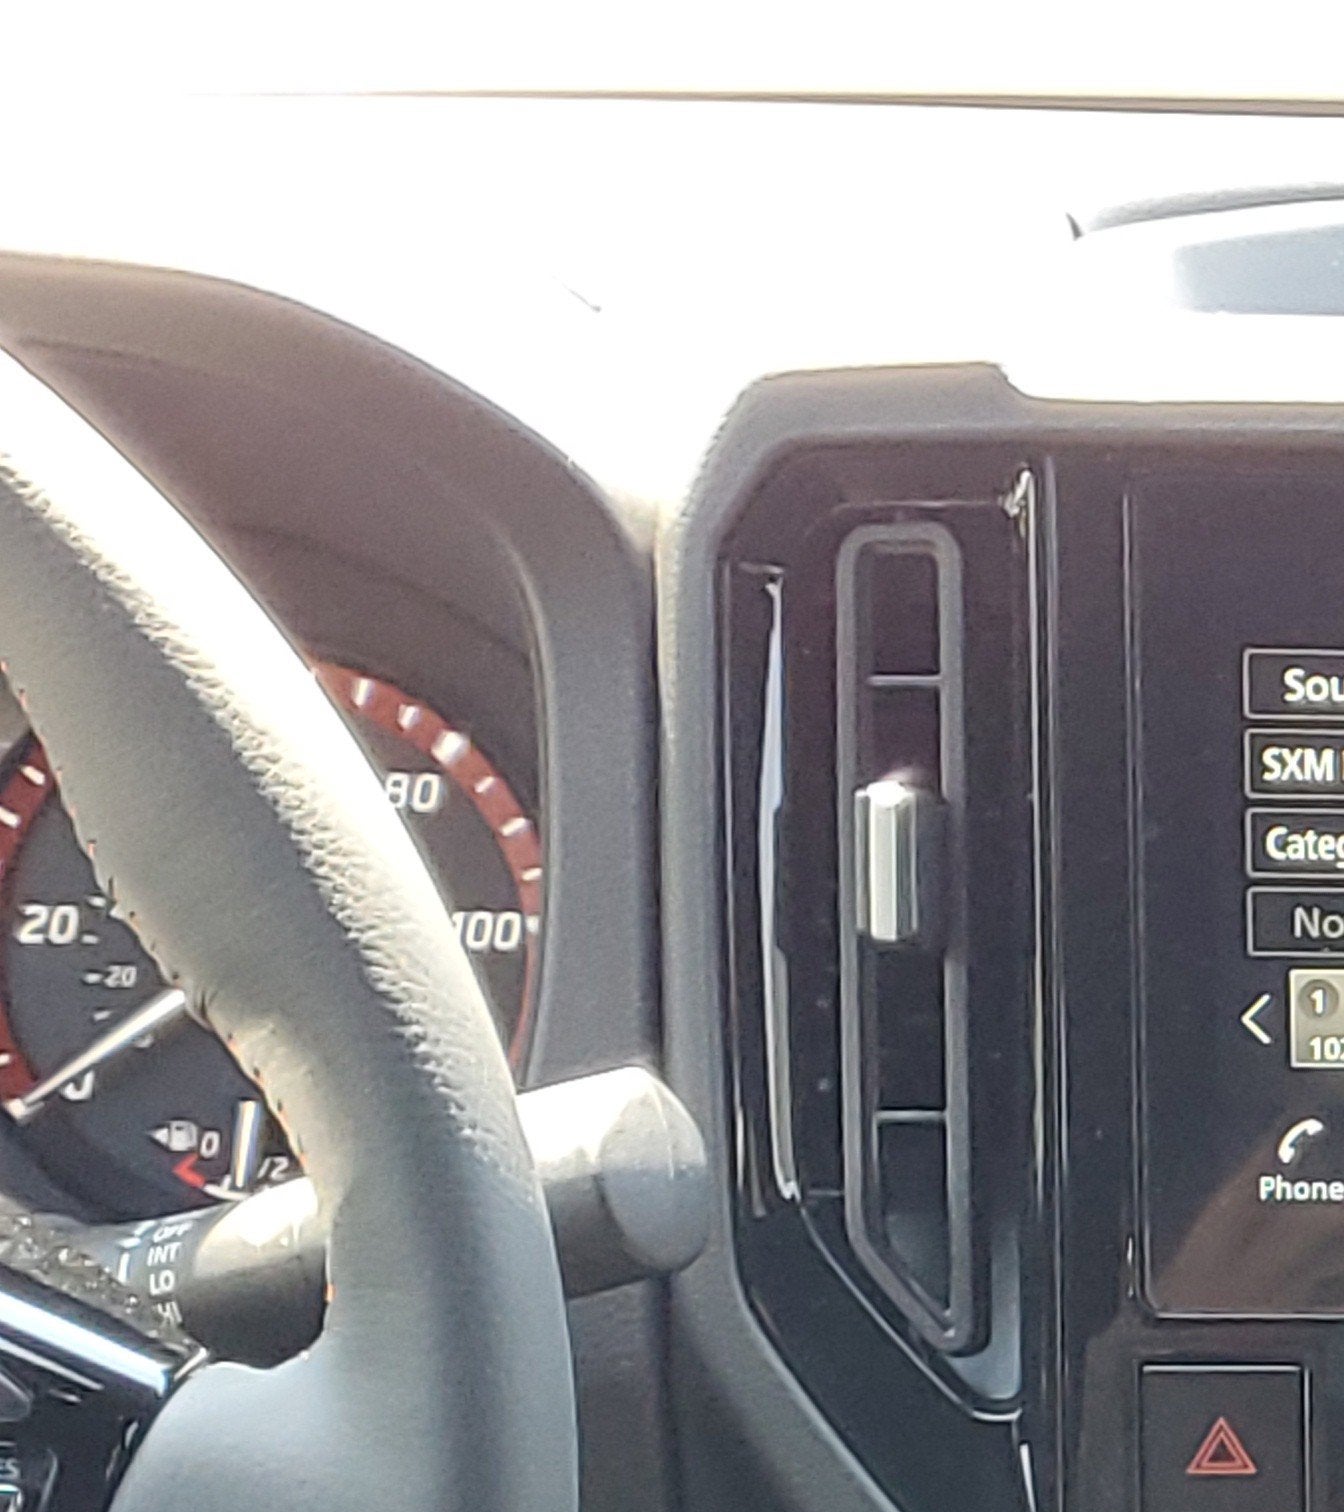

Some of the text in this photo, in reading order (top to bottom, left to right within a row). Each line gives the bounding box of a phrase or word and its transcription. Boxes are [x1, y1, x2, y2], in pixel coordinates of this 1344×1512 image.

[1262, 747, 1334, 783] SXM
[16, 904, 79, 944] 20
[103, 966, 138, 988] 20
[1310, 990, 1325, 1014] 1
[147, 1242, 183, 1266] INT
[150, 1270, 176, 1295] LO
